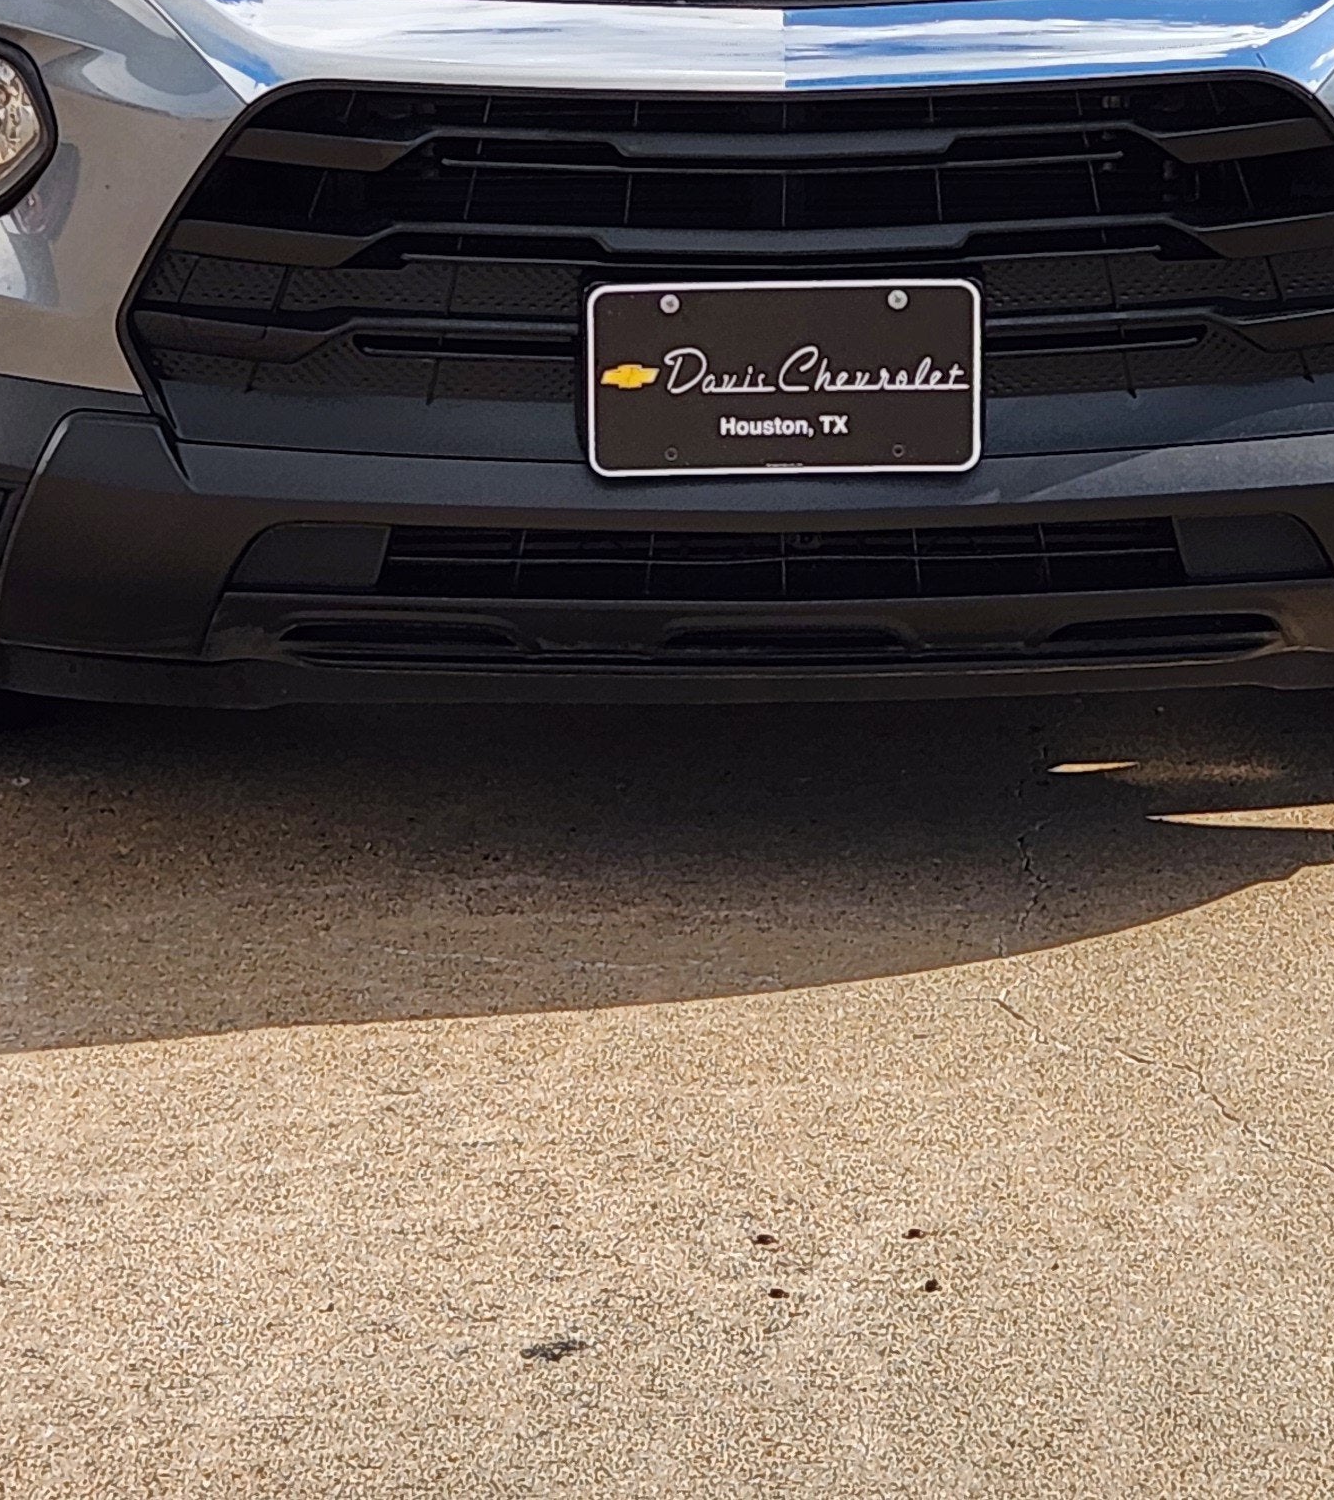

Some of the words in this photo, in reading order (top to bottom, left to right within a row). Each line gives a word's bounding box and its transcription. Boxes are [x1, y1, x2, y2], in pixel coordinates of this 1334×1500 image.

[664, 347, 775, 394] Davis
[778, 345, 970, 393] Chevrolet
[719, 415, 814, 439] Houston,
[820, 414, 849, 435] TX
